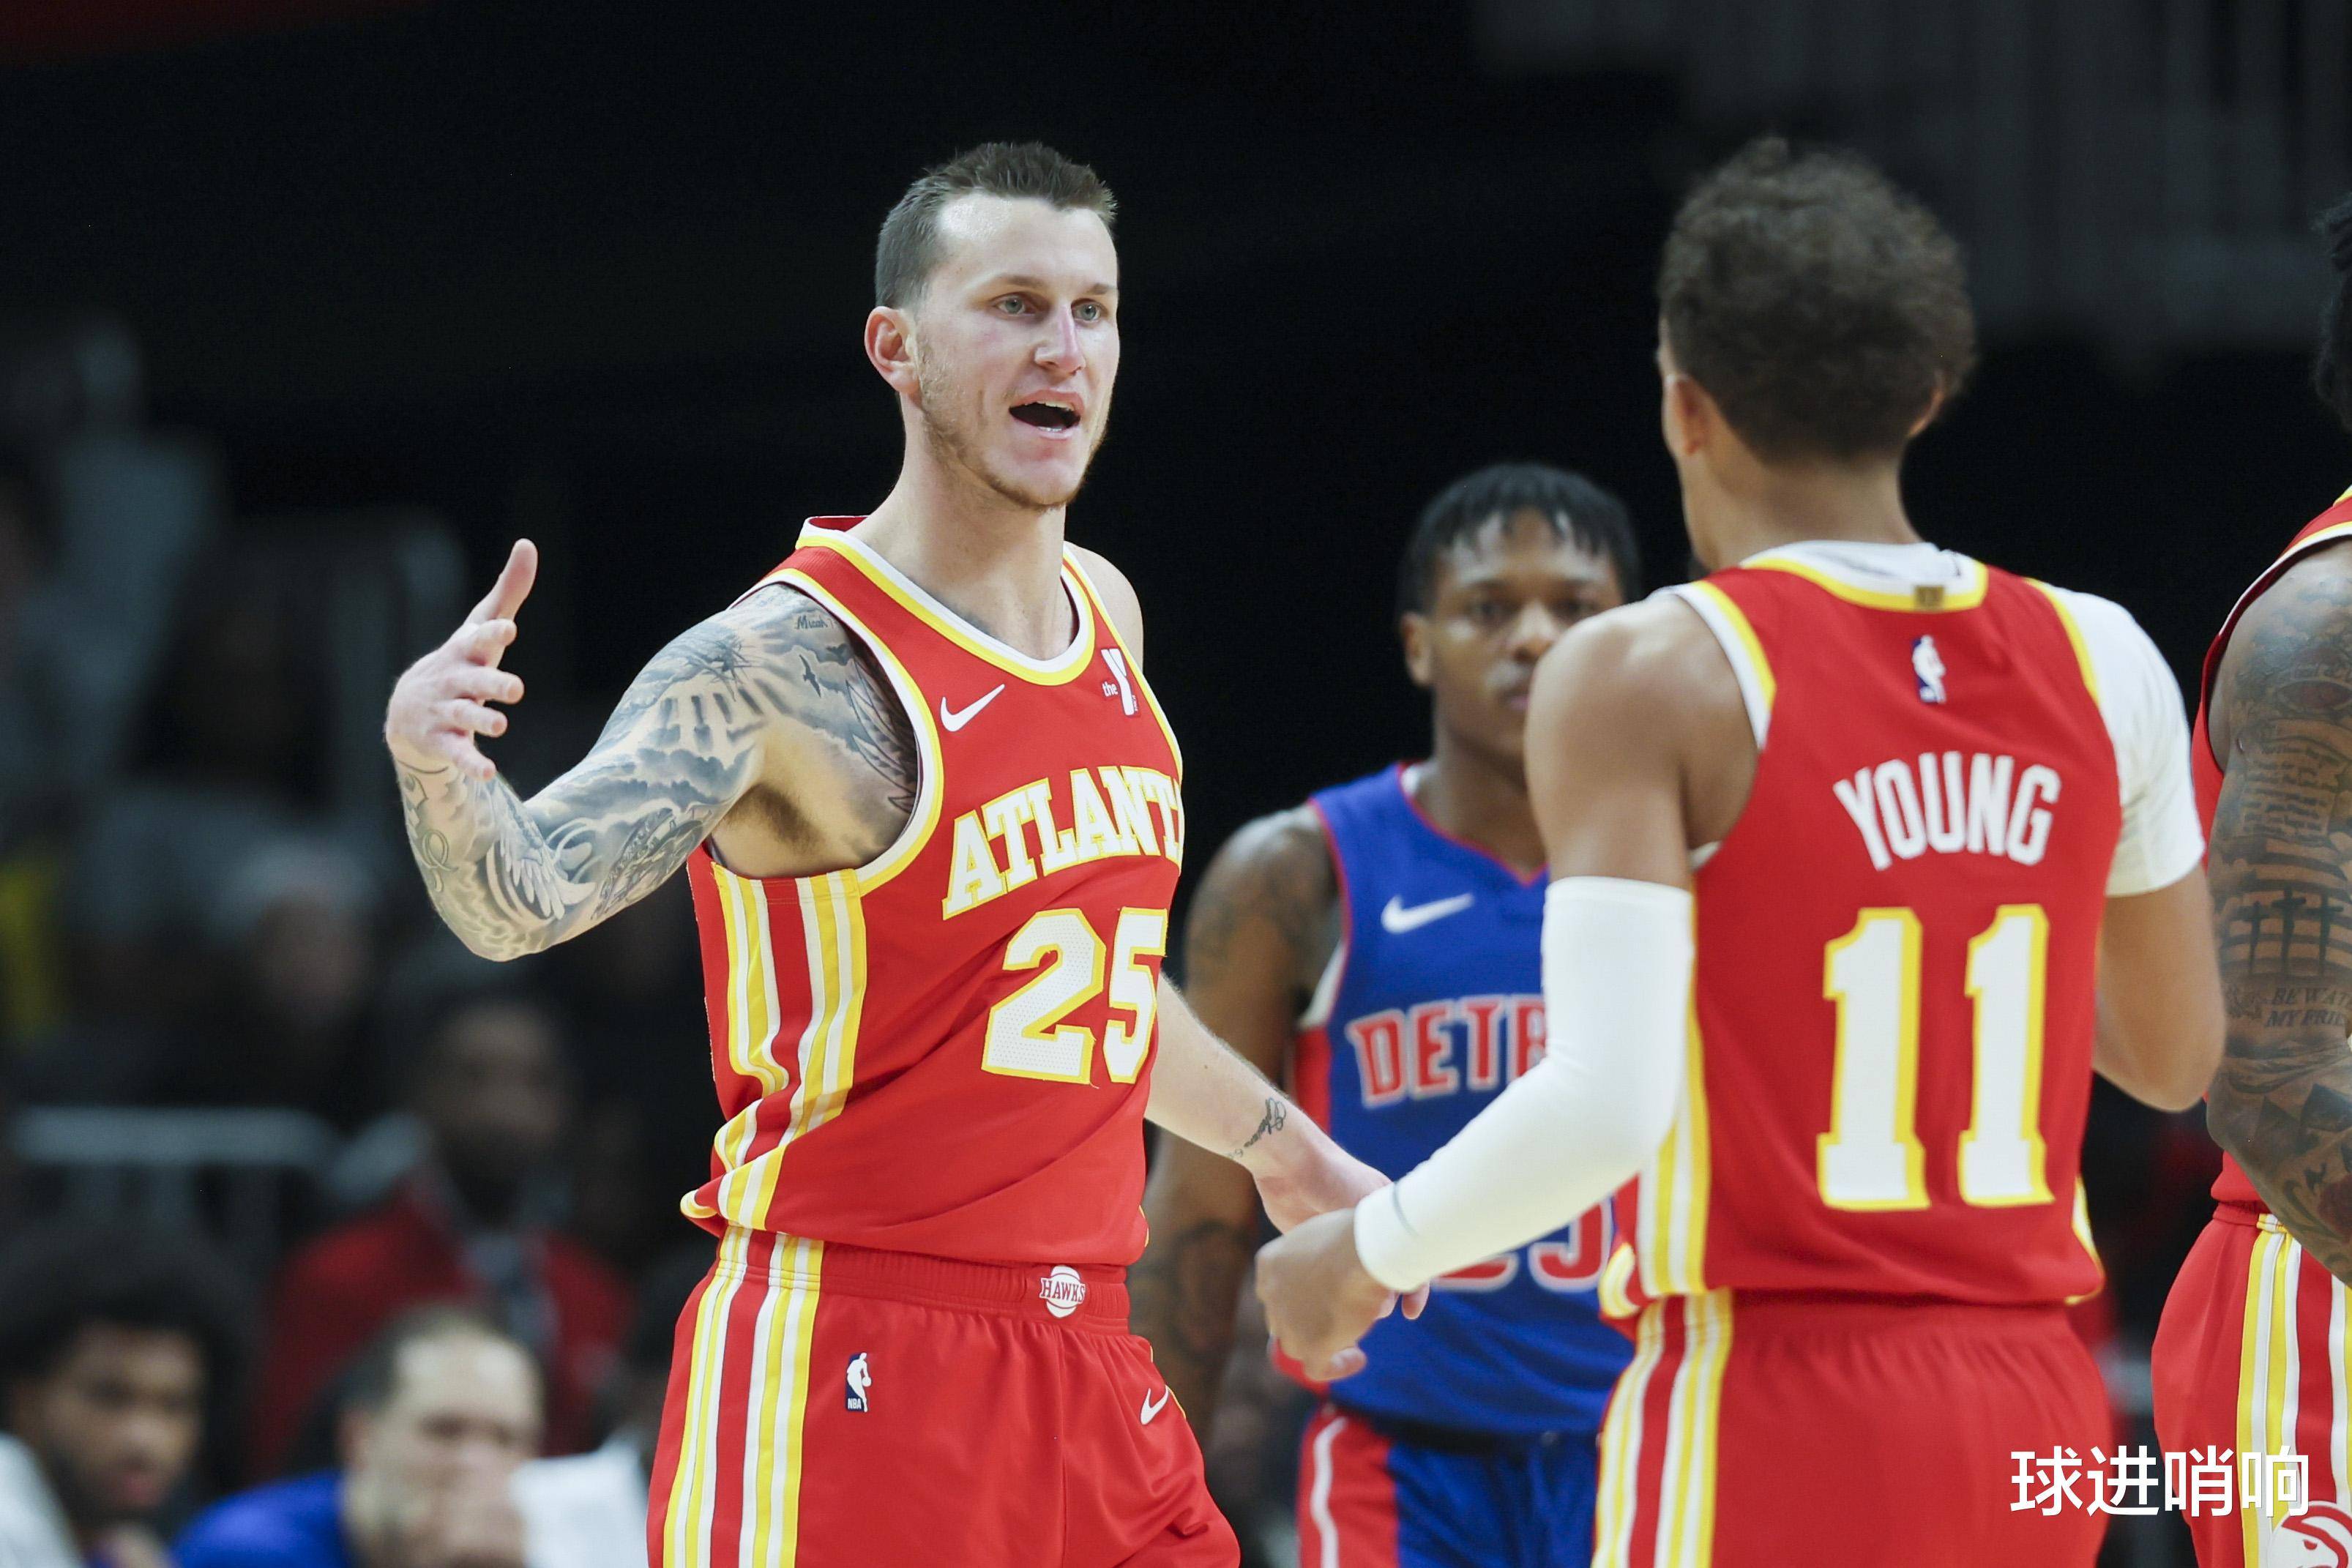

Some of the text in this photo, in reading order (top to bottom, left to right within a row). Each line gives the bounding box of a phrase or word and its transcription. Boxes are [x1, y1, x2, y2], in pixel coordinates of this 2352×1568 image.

[1100, 648, 1135, 715] the Y
[941, 765, 1185, 920] ATLANT
[1832, 750, 2062, 871] YOUNG
[981, 906, 1168, 1085] 25
[1815, 903, 2056, 1212] 11
[1039, 1278, 1086, 1304] HAWKS
[847, 1397, 862, 1410] NBA
